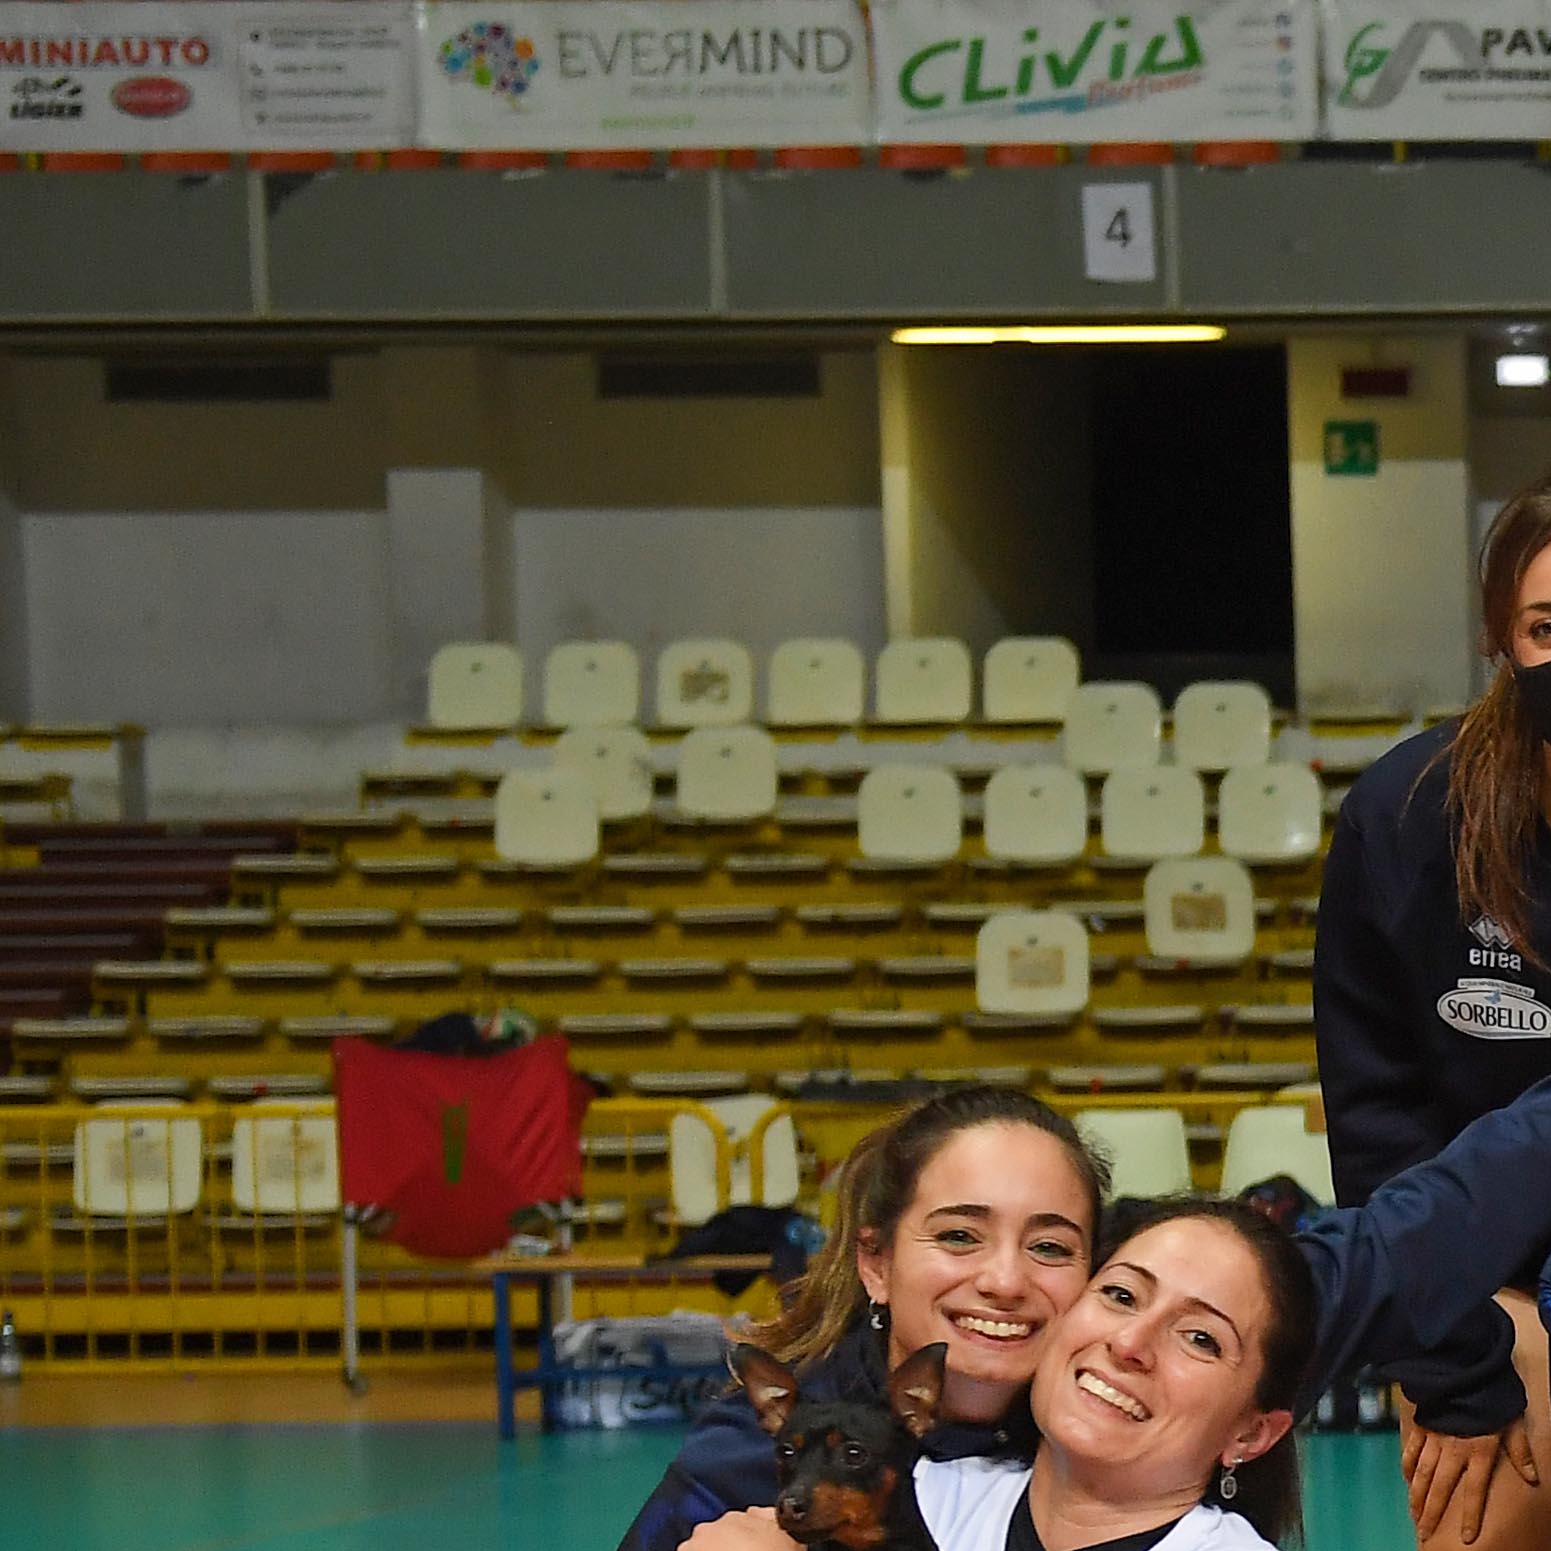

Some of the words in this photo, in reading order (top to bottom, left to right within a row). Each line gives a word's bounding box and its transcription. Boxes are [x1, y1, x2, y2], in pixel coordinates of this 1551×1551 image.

[0, 37, 210, 67] MINIAUTO
[1105, 207, 1132, 248] 4
[1469, 948, 1522, 972] errea
[1446, 1000, 1548, 1032] SORBELLO
